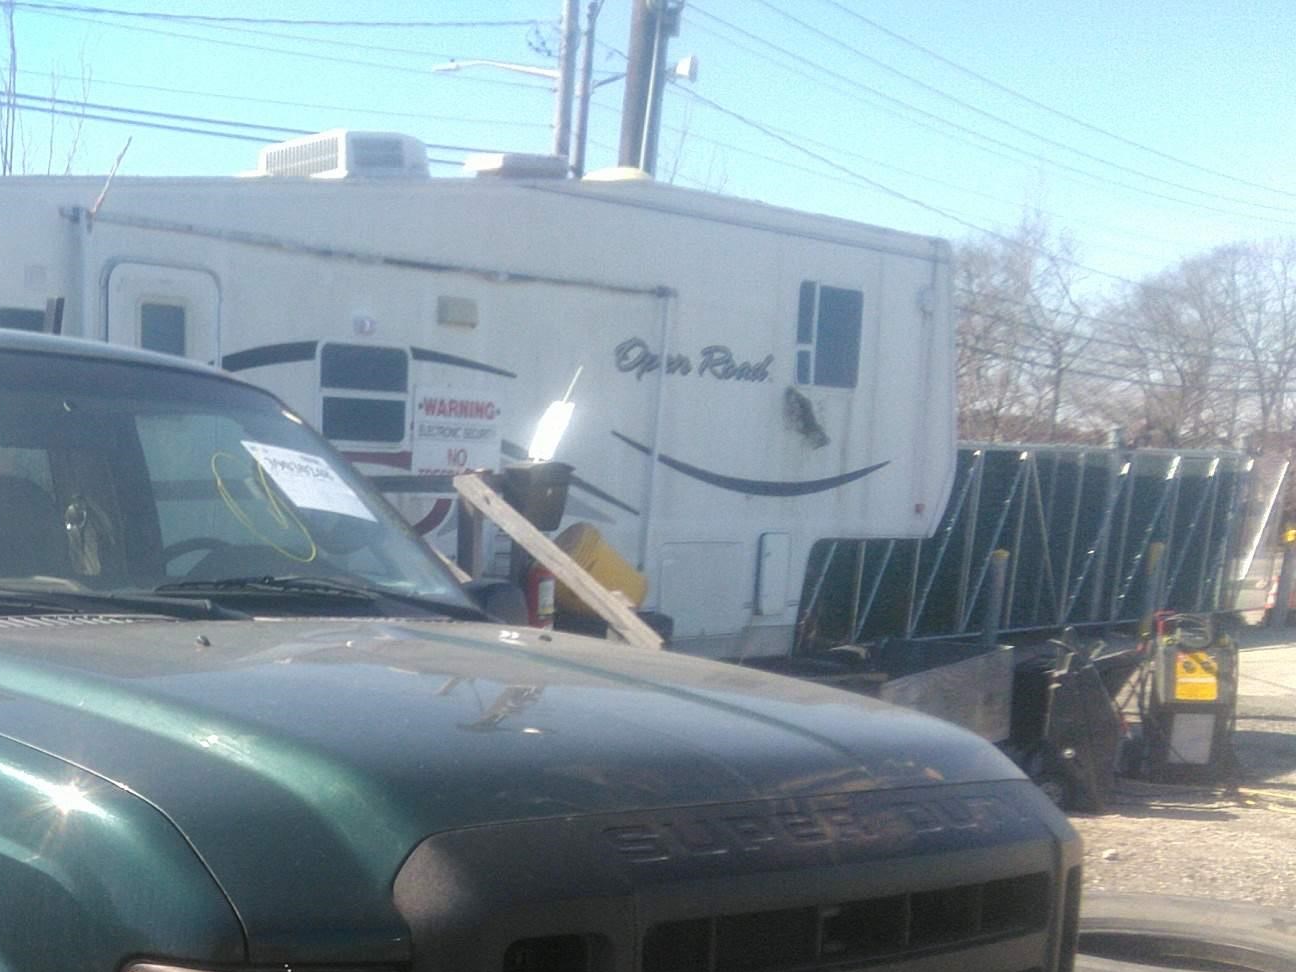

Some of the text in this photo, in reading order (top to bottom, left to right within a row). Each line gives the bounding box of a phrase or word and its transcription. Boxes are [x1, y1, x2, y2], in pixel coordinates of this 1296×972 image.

[698, 345, 774, 382] Road
[423, 397, 496, 421] WARNING
[447, 447, 468, 467] NO
